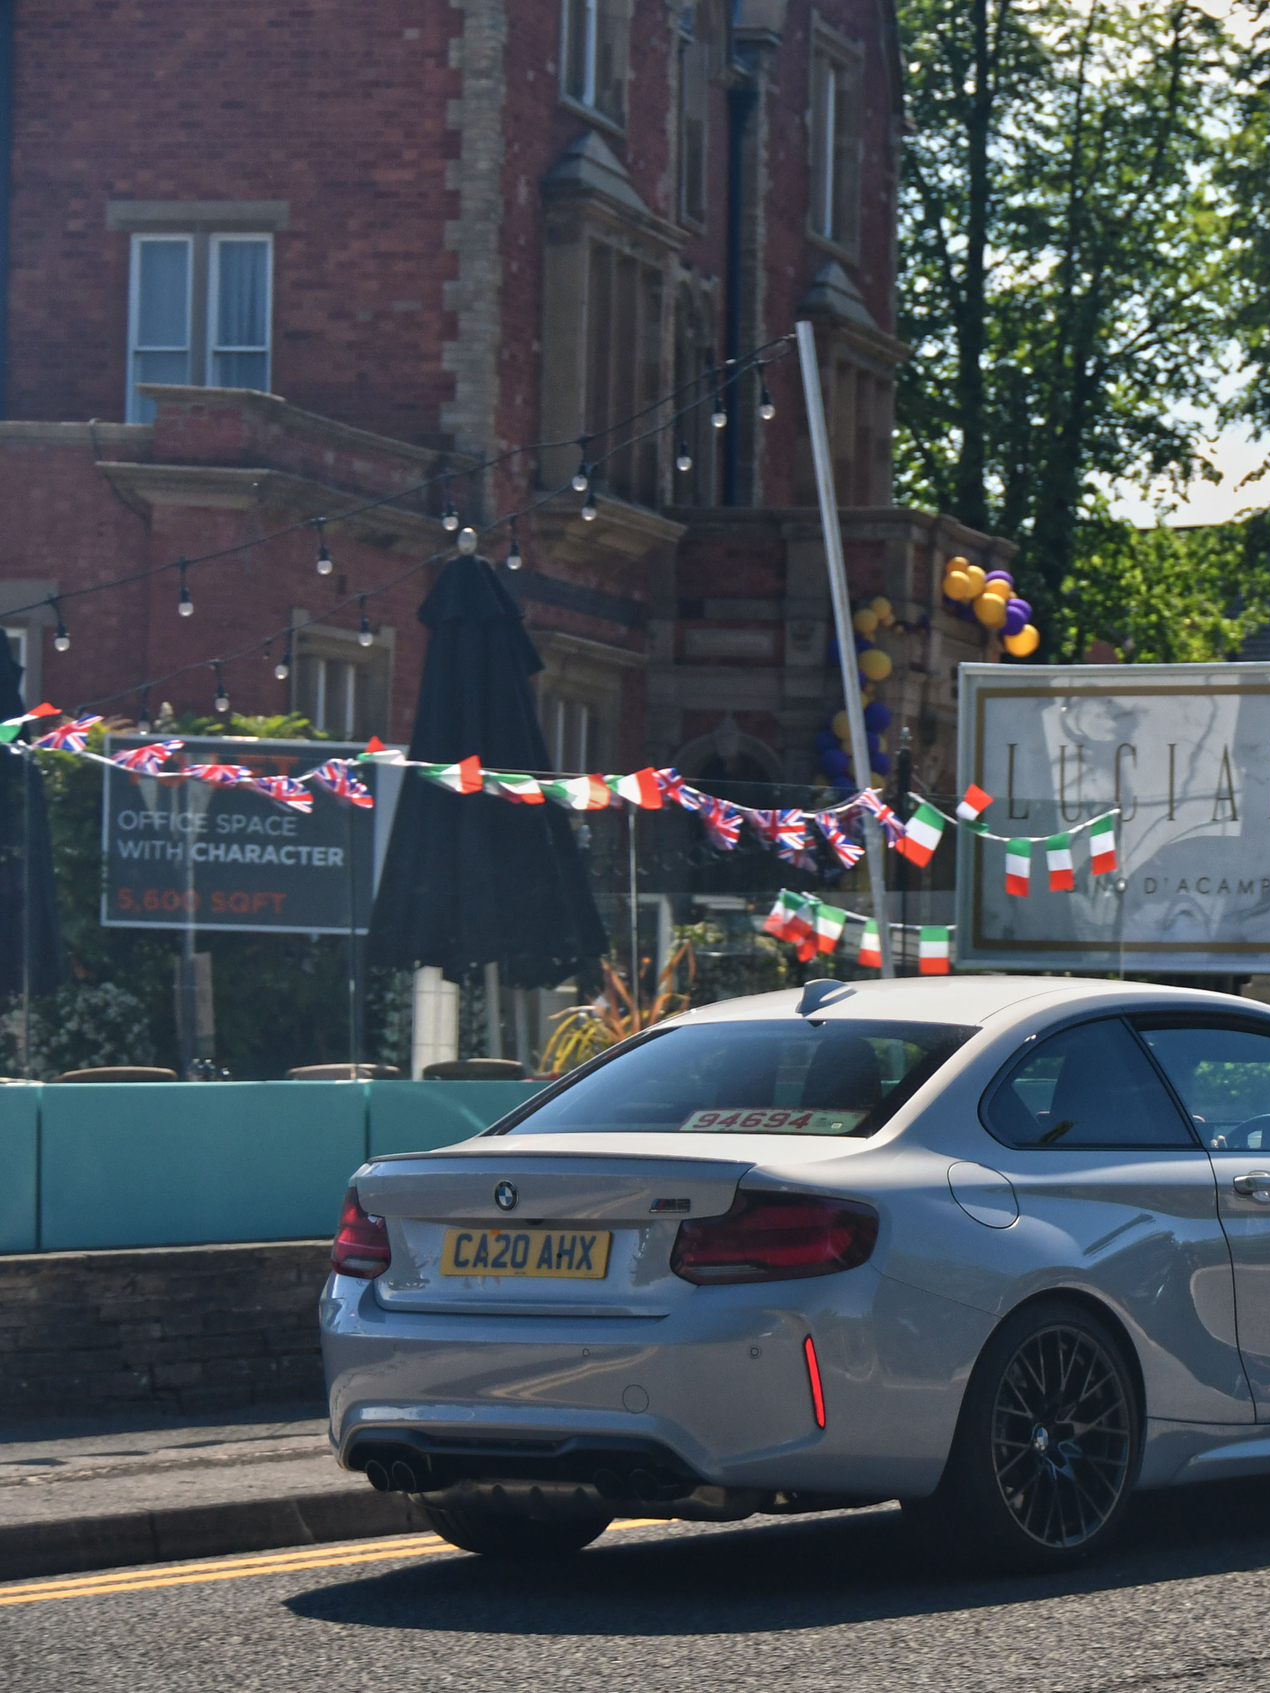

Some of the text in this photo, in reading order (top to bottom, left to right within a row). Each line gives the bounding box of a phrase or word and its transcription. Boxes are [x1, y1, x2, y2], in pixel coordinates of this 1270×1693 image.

[117, 809, 298, 837] OFFICE SPACE
[117, 840, 344, 867] WITH CHARACTER
[117, 887, 287, 914] 5,600 SQFT
[692, 1112, 814, 1130] 94694
[453, 1233, 597, 1271] CA20 AHX
